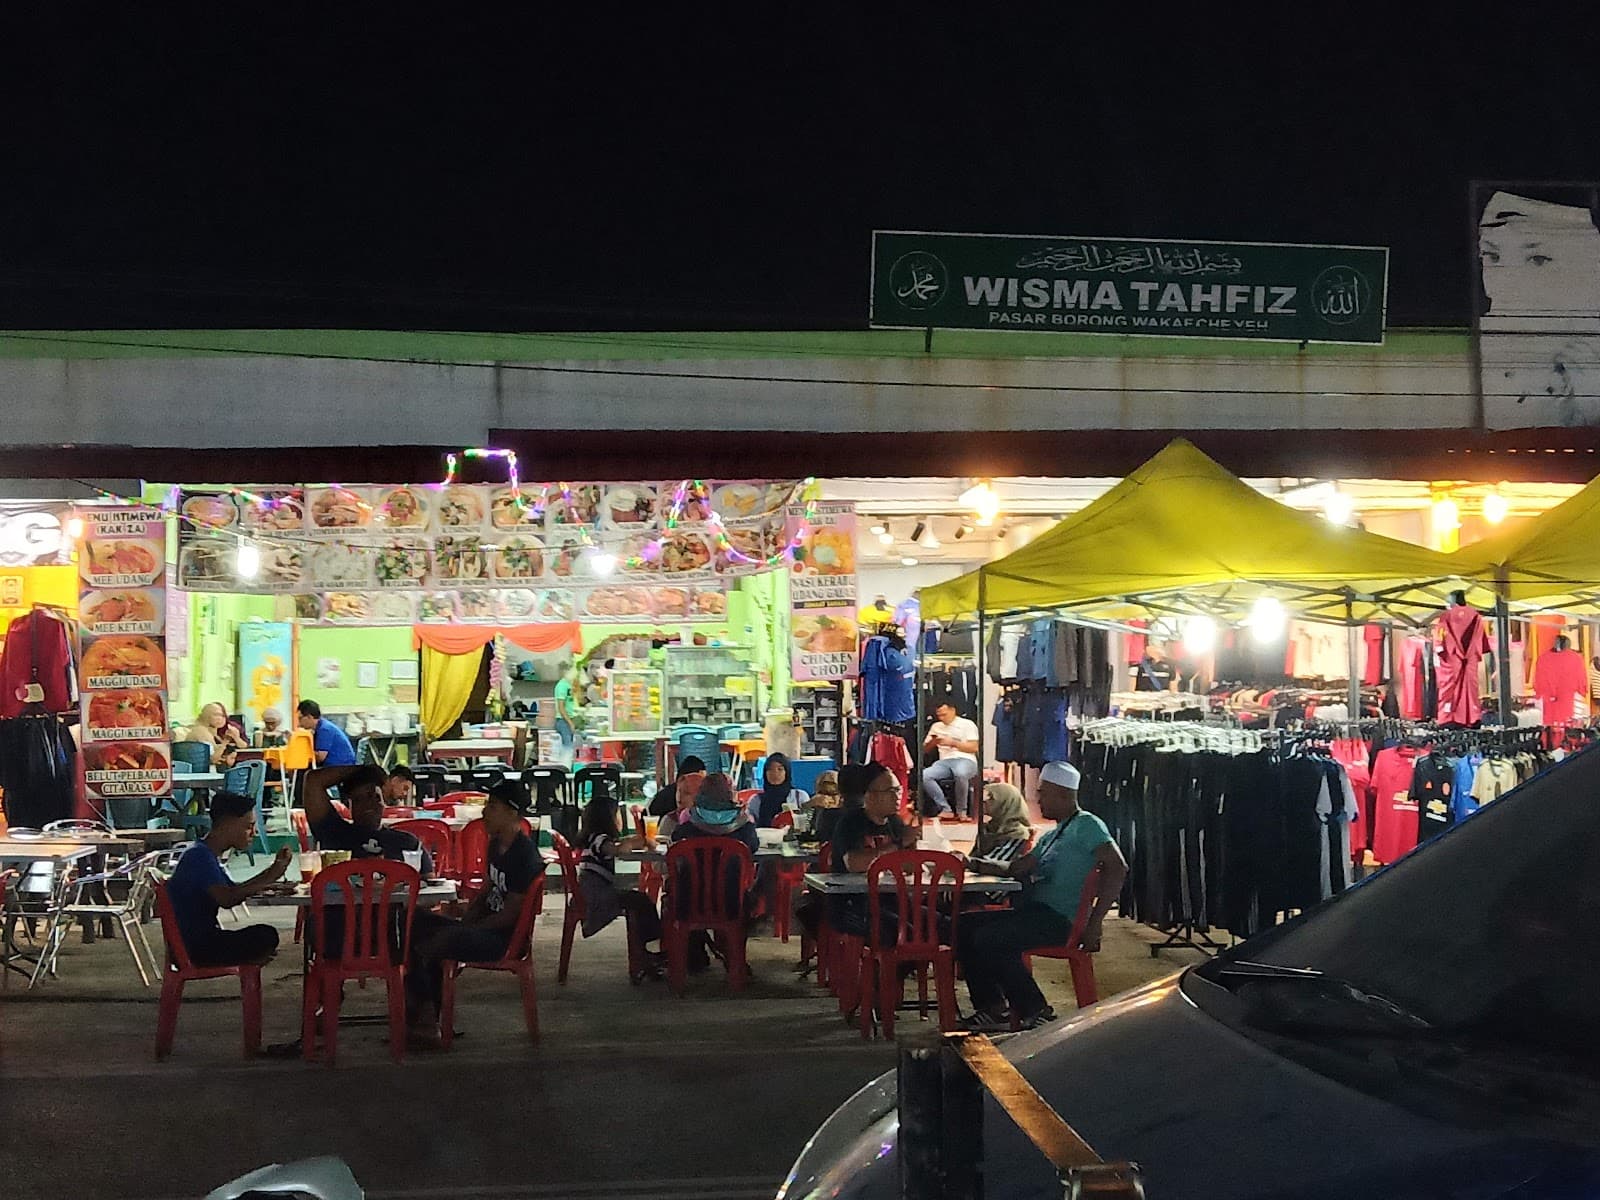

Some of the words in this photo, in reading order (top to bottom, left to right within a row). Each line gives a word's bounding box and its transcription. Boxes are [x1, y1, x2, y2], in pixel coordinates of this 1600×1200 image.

[963, 276, 1123, 310] WISMA
[1130, 281, 1297, 314] TAHFIZ
[989, 311, 1048, 324] PASAR
[1051, 312, 1127, 327] BORONG
[94, 575, 113, 585] MEE
[117, 573, 151, 584] UDANG
[95, 623, 114, 633] MEE
[118, 622, 152, 632] KETAM
[801, 652, 853, 665] CHICKEN
[810, 664, 848, 676] CHOP
[89, 677, 123, 687] MAGGI
[125, 675, 161, 686] UDANG
[92, 729, 125, 739] MAGGI
[127, 727, 161, 737] KETAM
[127, 782, 153, 793] RASA
